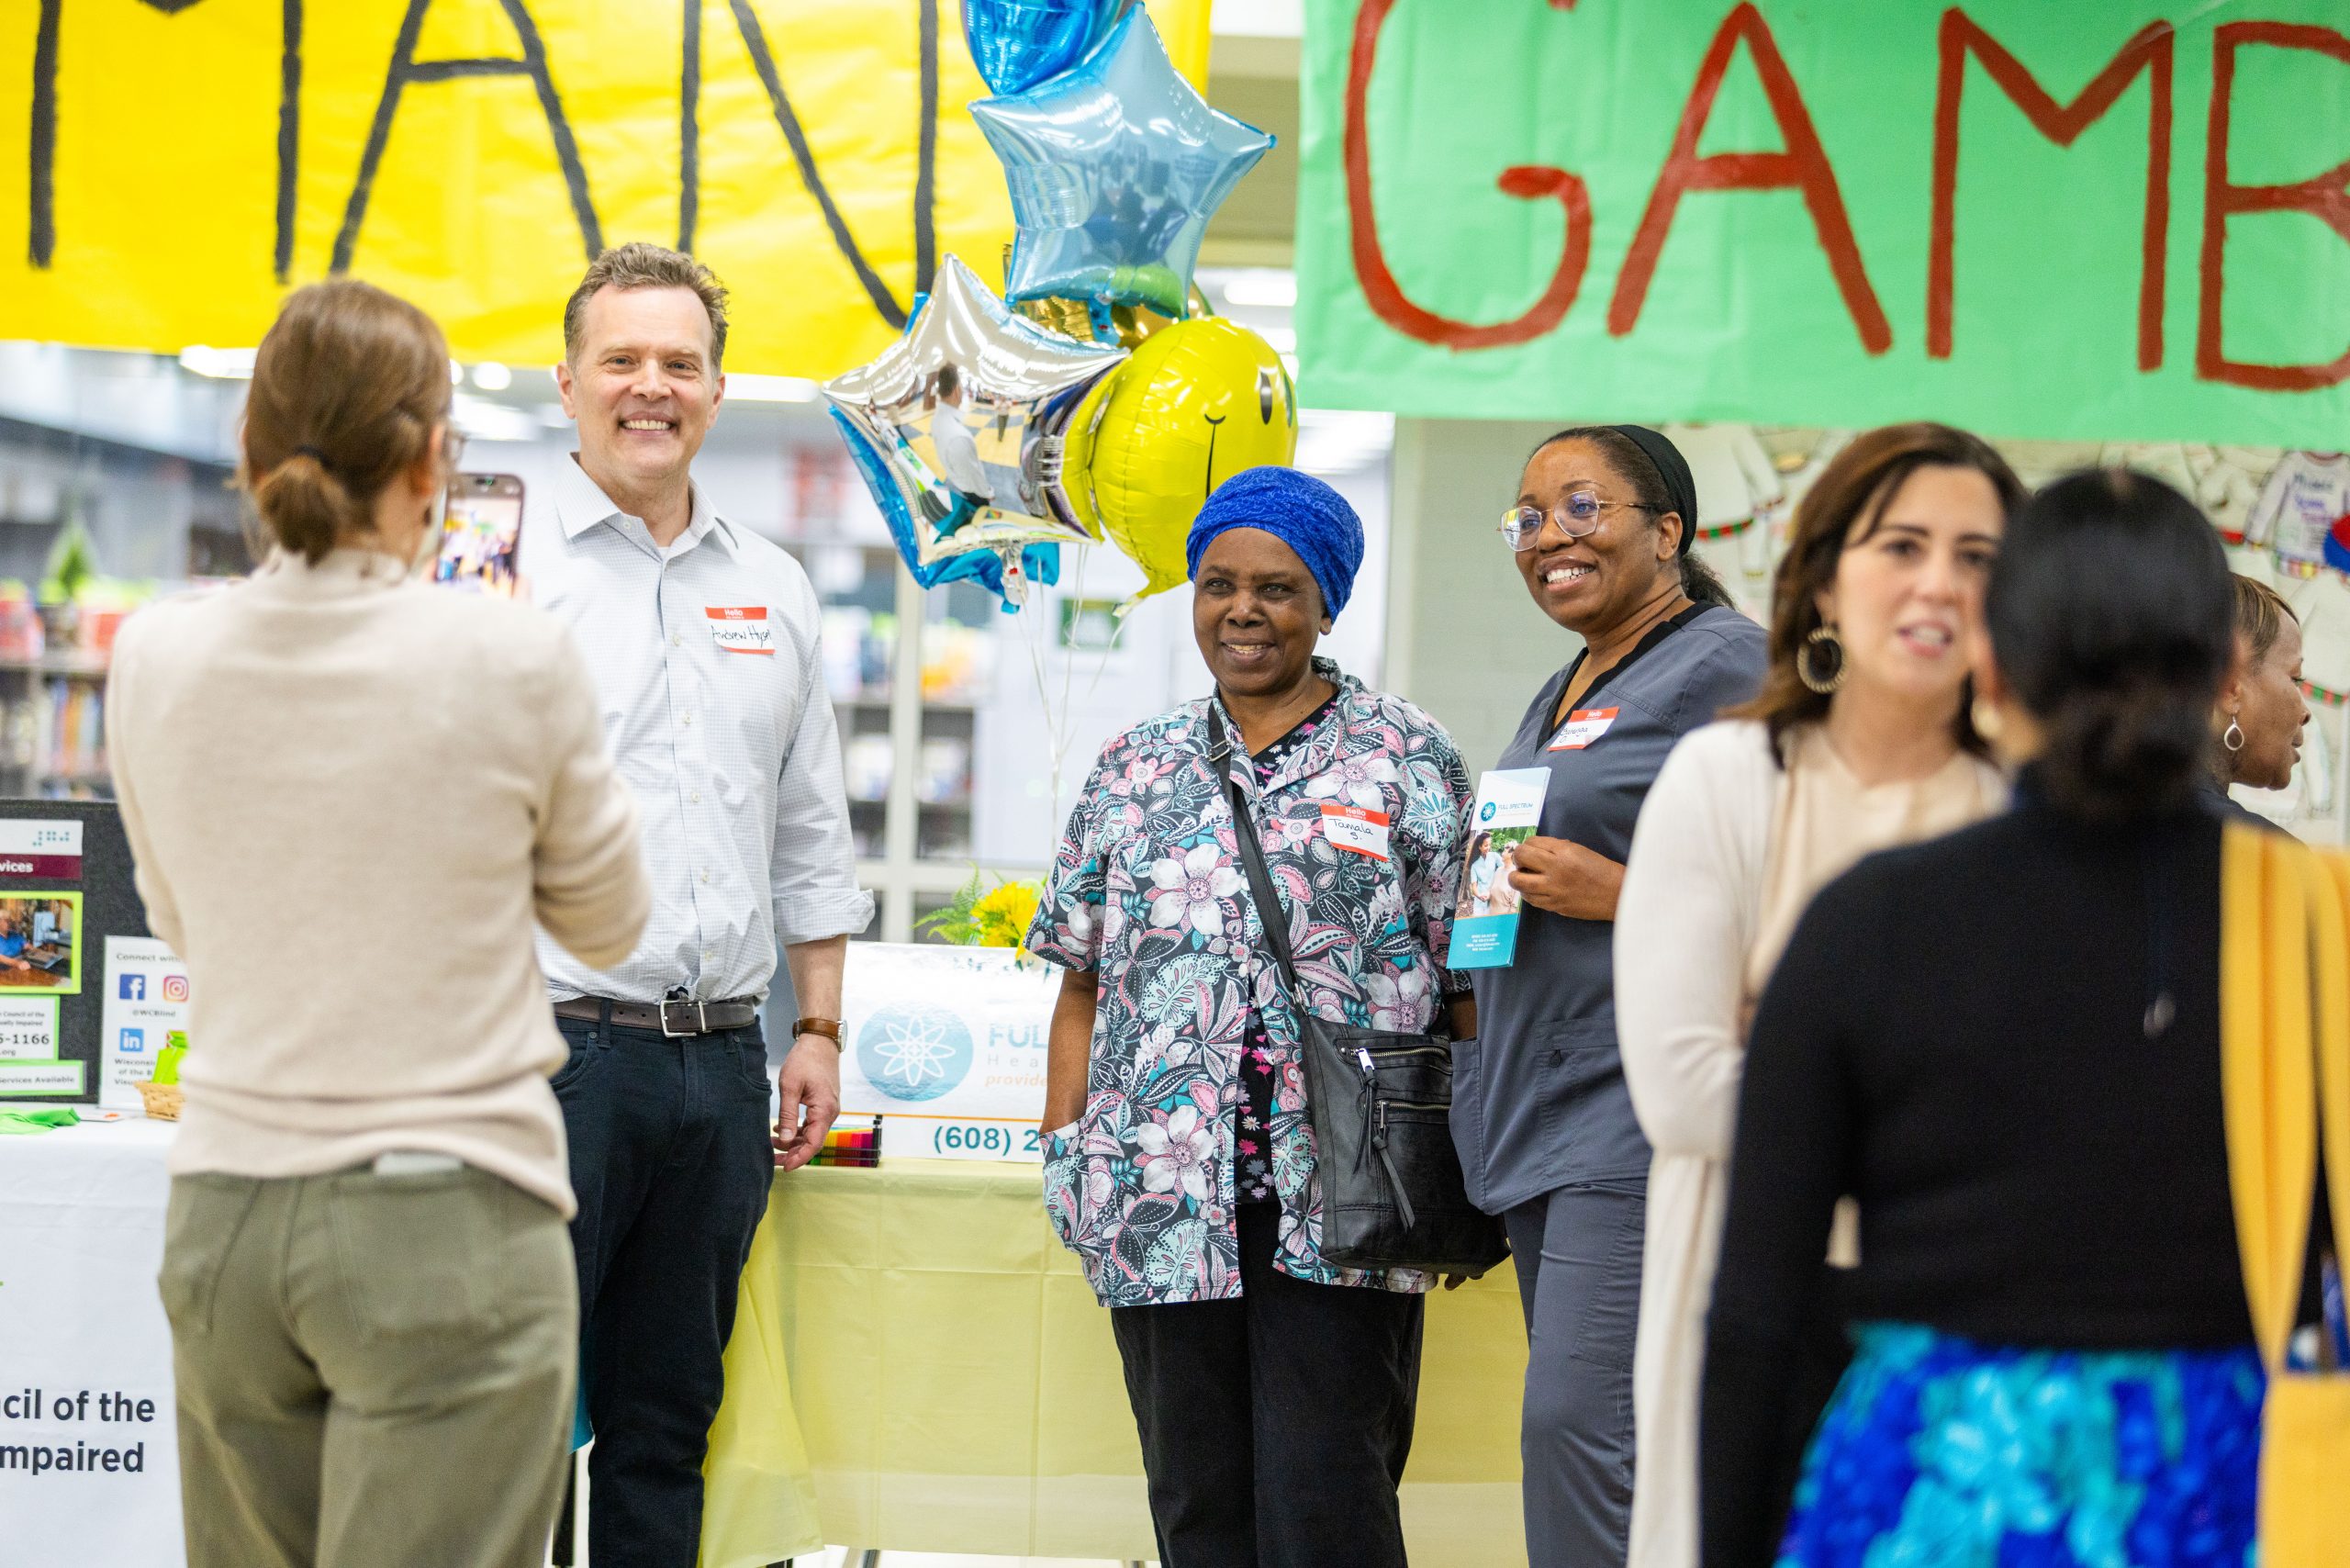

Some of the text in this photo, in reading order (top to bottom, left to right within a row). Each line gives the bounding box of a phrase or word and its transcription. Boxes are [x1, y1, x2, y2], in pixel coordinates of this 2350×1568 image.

[1342, 0, 2350, 391] GAMB
[1345, 808, 1366, 816] Hello
[1328, 818, 1373, 835] Tamala
[0, 859, 34, 873] vices
[116, 953, 156, 962] Connect
[132, 1009, 176, 1017] @WCBlind
[934, 1126, 1011, 1157] (608)
[0, 1388, 155, 1423] cil of the
[0, 1440, 144, 1476] mpaired
